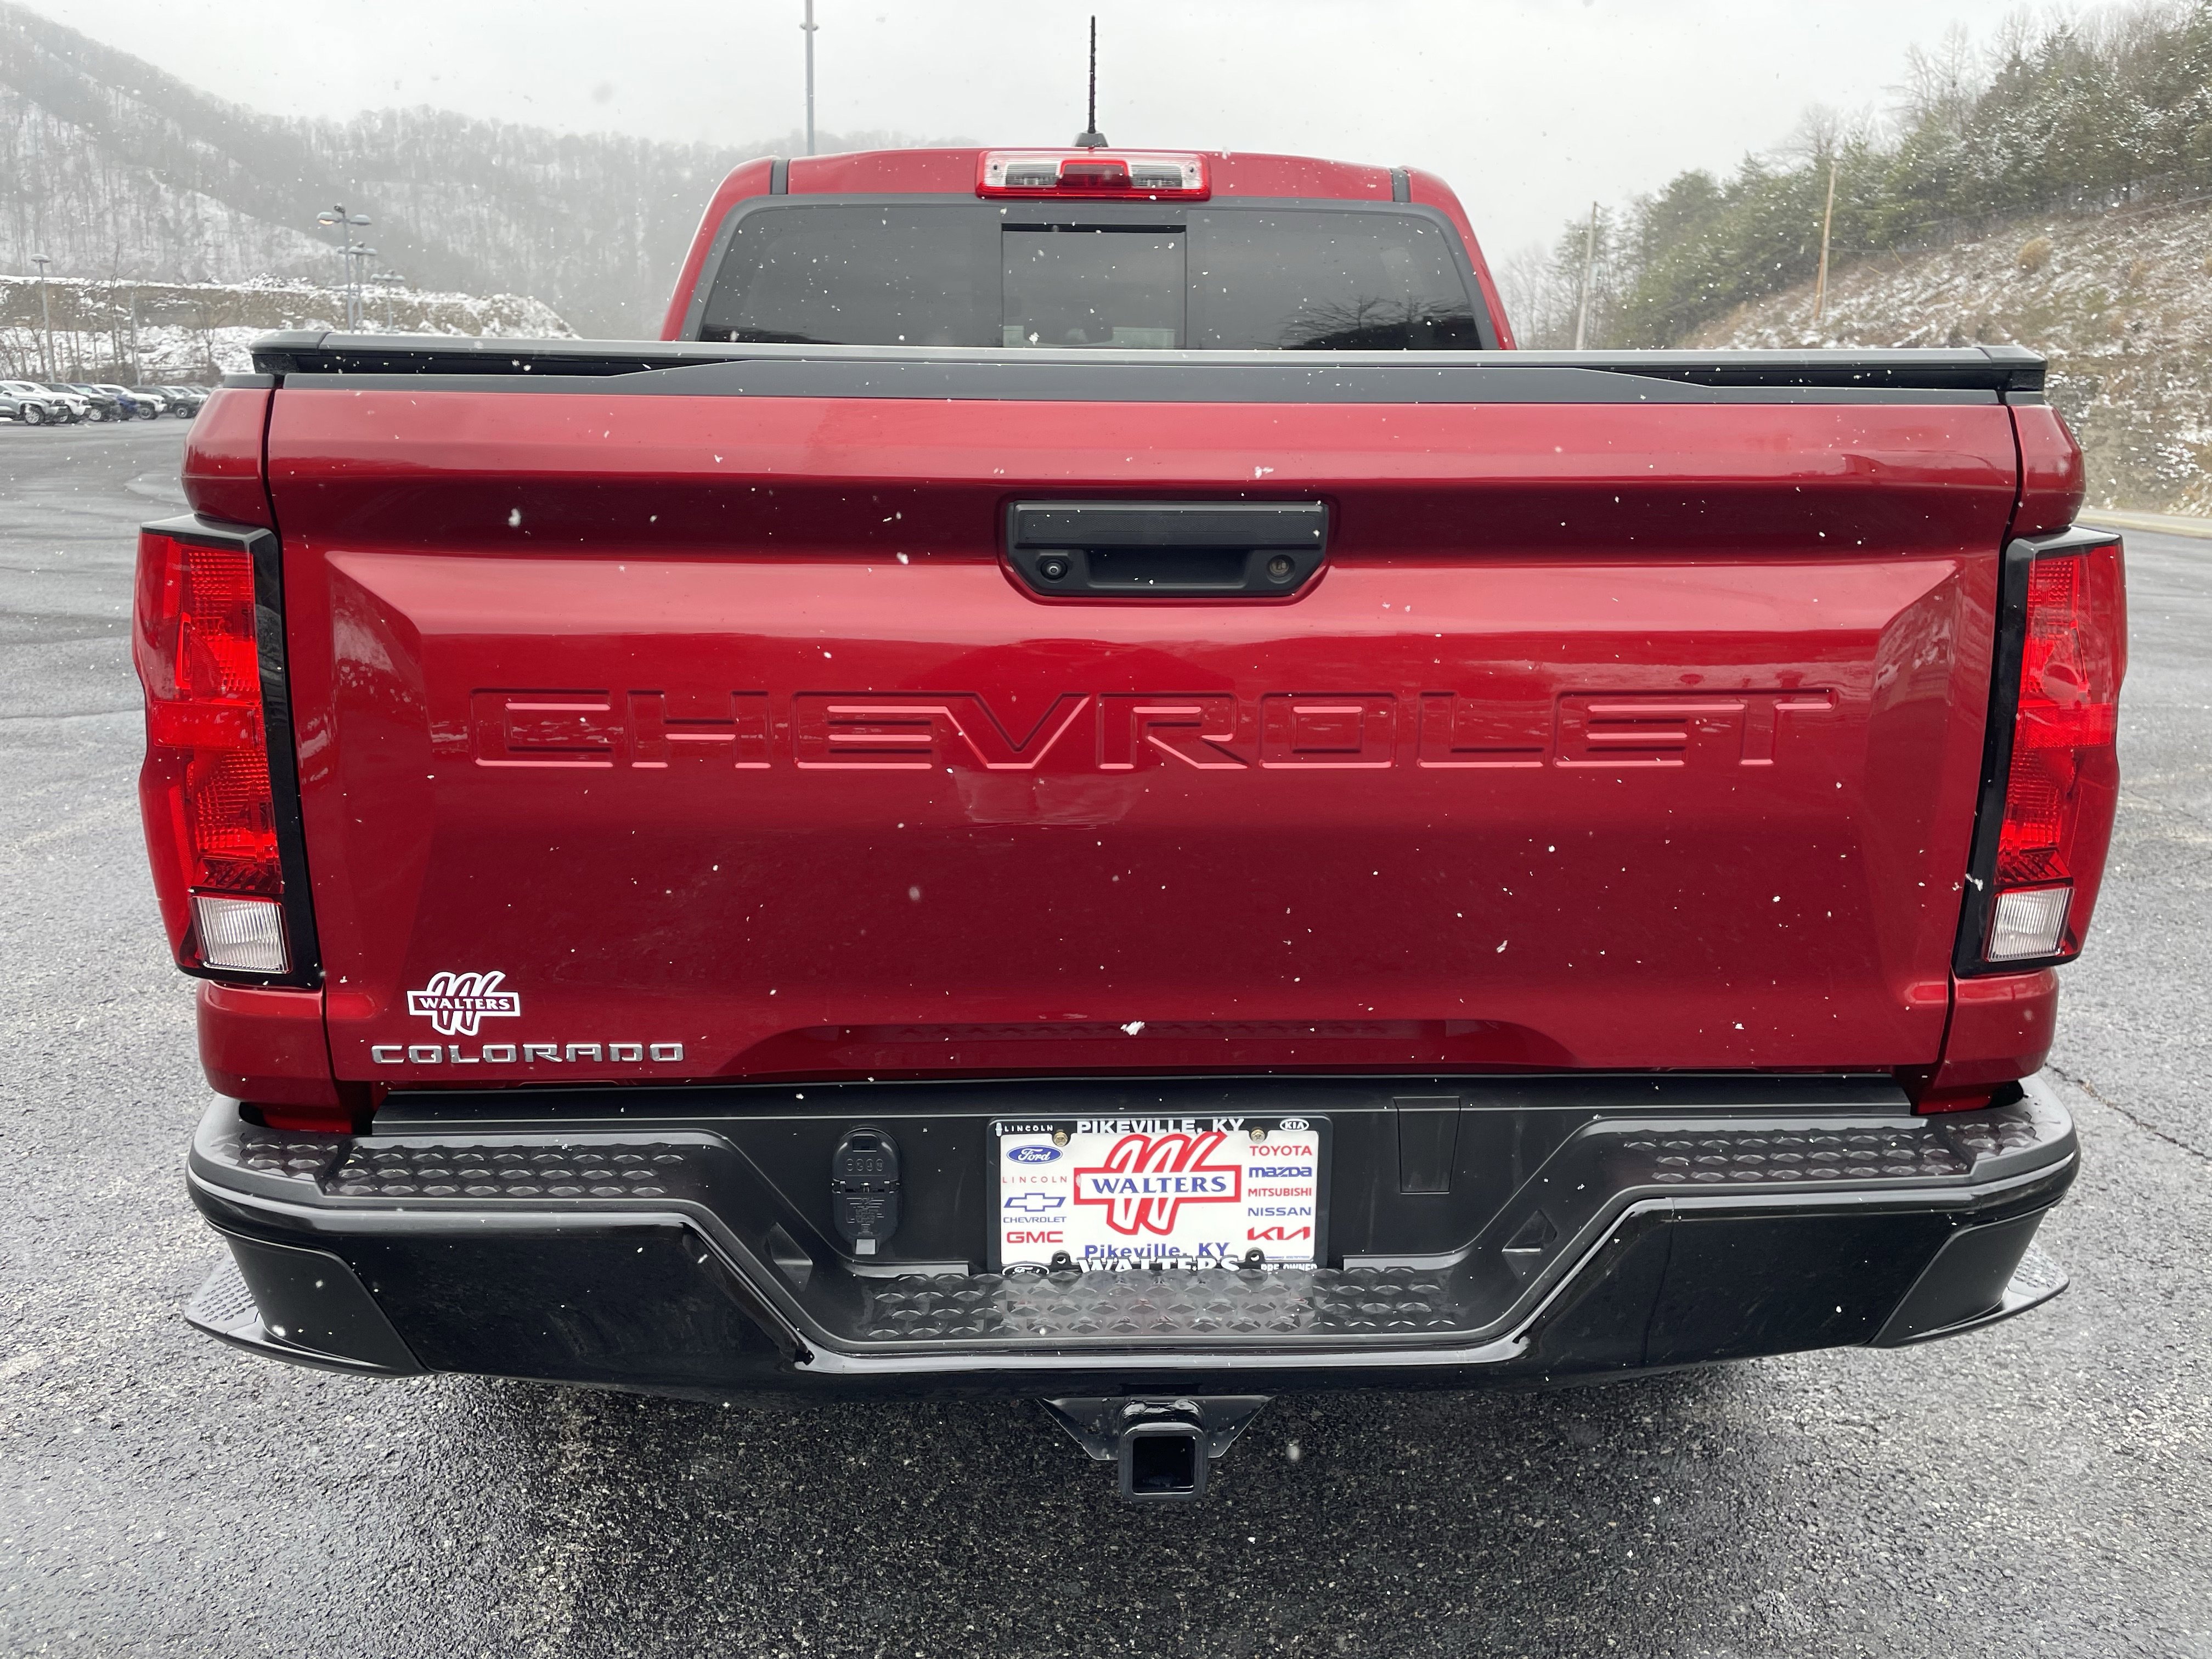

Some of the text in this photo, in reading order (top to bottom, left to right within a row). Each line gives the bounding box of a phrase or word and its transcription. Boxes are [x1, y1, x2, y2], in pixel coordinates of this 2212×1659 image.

[469, 687, 1837, 769] CHEVROLET
[419, 997, 510, 1010] WALTERS
[371, 1043, 685, 1064] COLORADO
[1076, 1118, 1244, 1135] PIKEVILLE, KY
[1018, 1148, 1052, 1161] Ford
[1249, 1146, 1312, 1156] TOYOTA
[1090, 1176, 1227, 1194] WALTERS
[1248, 1188, 1312, 1197] MITSUBISHI
[1248, 1207, 1311, 1216] NISSAN
[1007, 1231, 1063, 1244] GMC
[1247, 1227, 1311, 1240] KIA
[1199, 1242, 1231, 1257] KY
